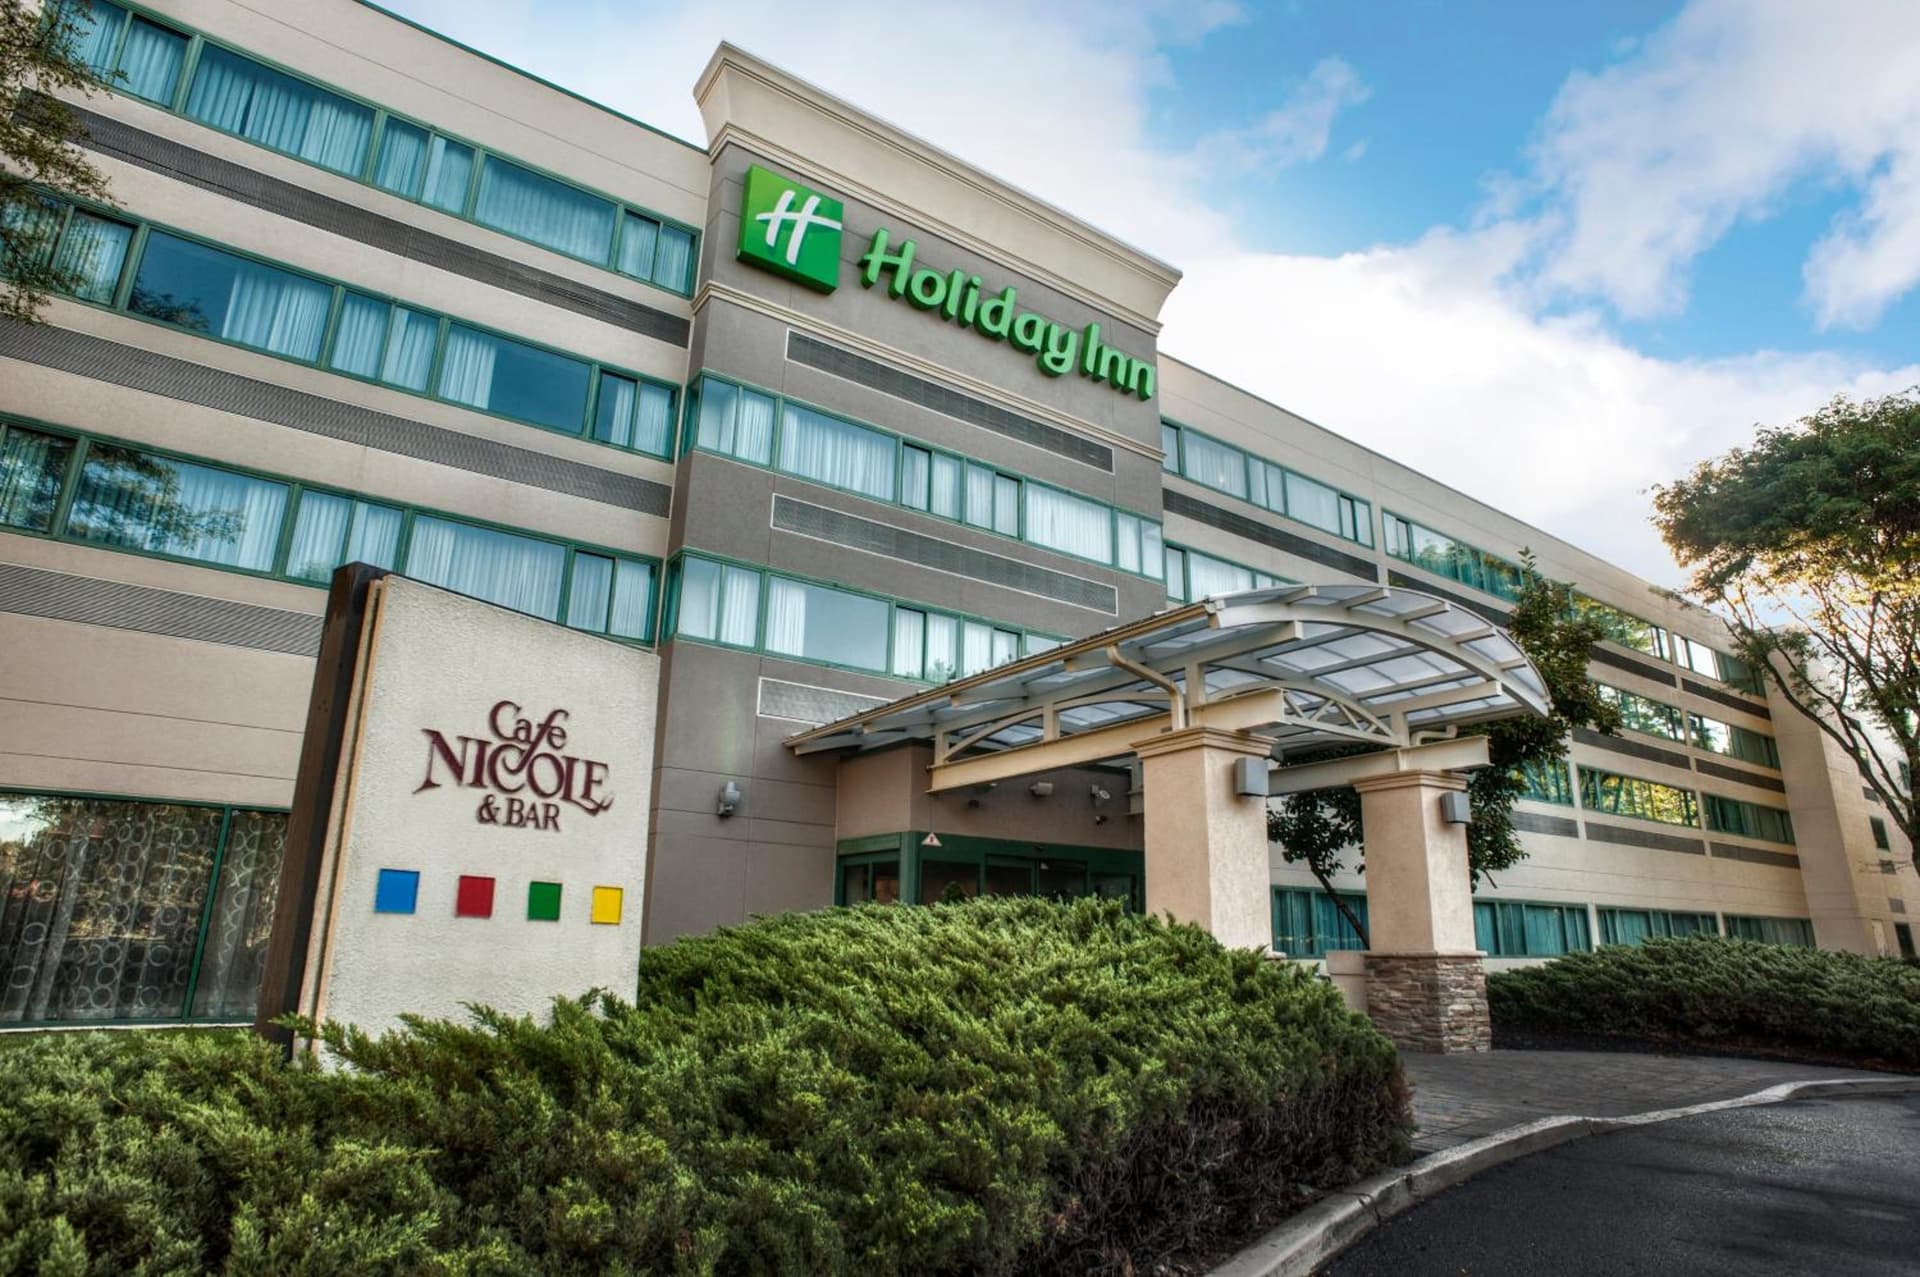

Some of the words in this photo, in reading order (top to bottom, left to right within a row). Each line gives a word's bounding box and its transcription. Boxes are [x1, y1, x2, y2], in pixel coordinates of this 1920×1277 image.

[858, 228, 1078, 378] Holiday
[1080, 322, 1157, 401] Inn
[412, 728, 615, 816] NICOLE
[476, 794, 501, 824] &
[502, 797, 562, 832] BAR
